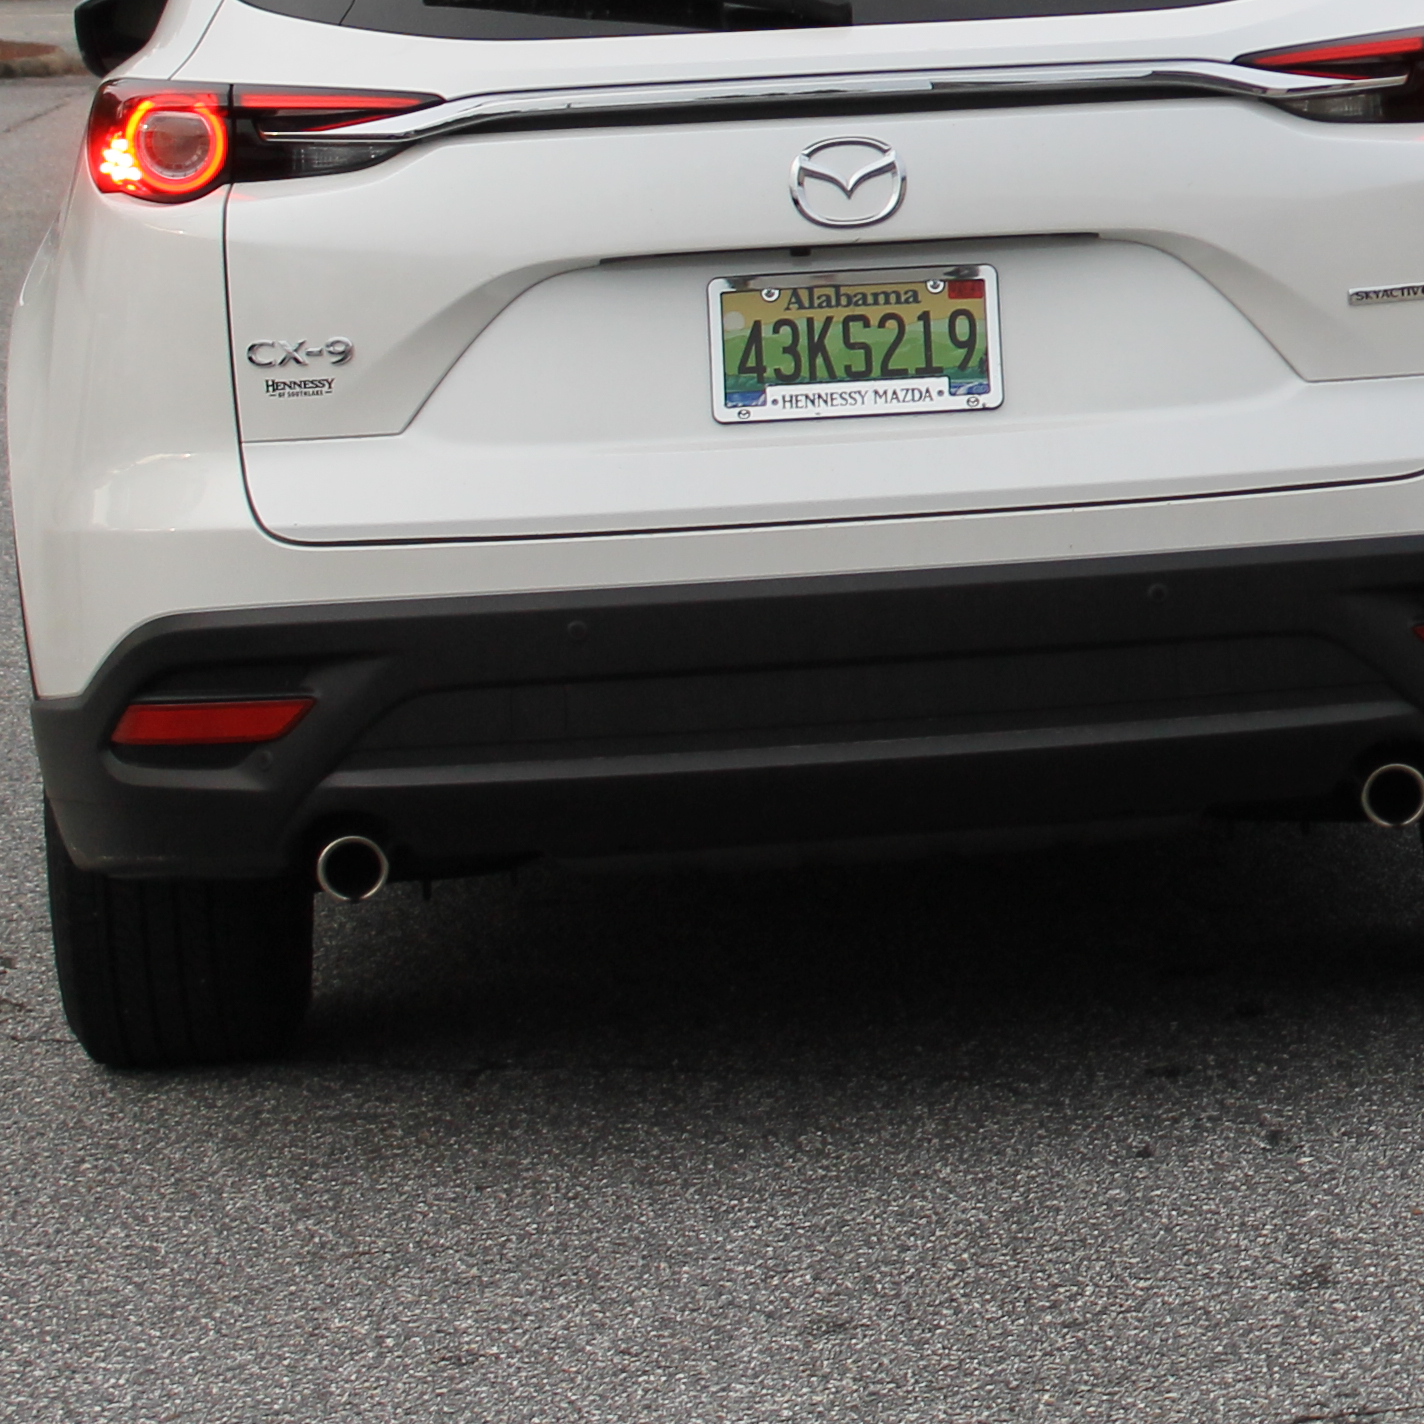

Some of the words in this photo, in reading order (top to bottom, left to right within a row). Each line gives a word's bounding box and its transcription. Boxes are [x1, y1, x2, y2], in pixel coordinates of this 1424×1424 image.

[784, 286, 922, 311] Alabama
[246, 336, 354, 367] CX-9
[738, 308, 977, 384] 43KS219
[782, 389, 868, 409] HENNESSY
[874, 387, 934, 404] MAZDA
